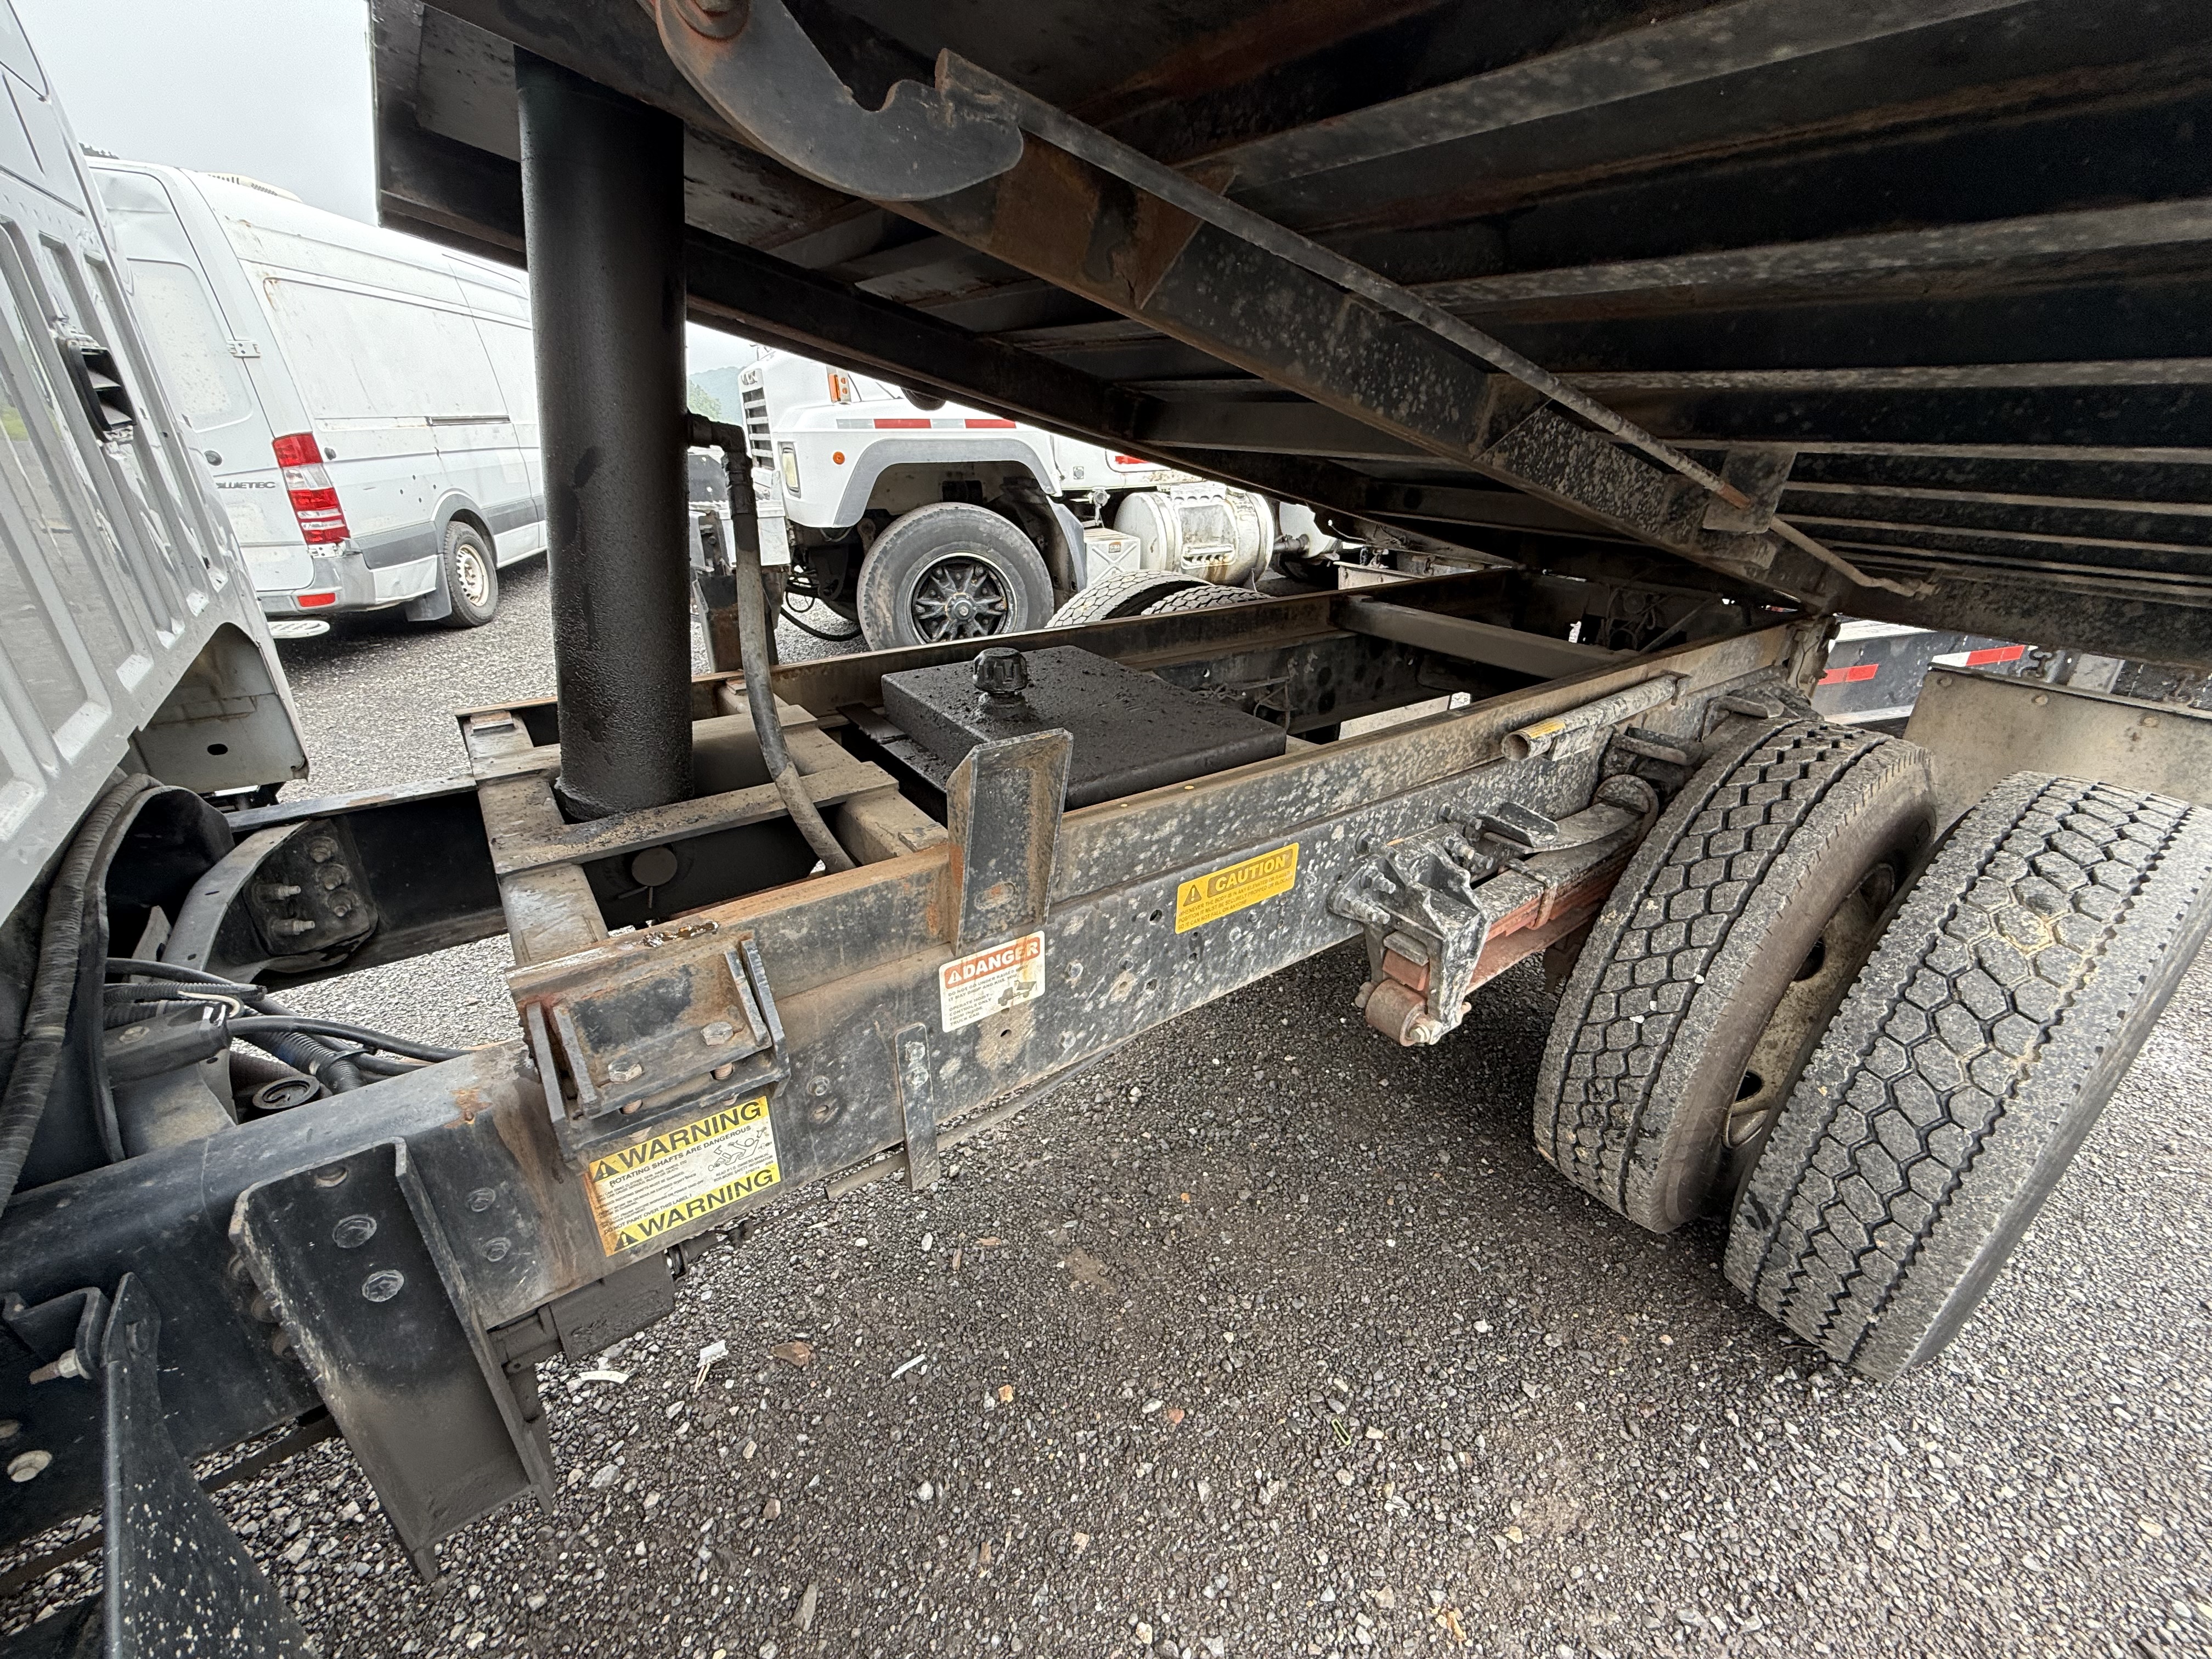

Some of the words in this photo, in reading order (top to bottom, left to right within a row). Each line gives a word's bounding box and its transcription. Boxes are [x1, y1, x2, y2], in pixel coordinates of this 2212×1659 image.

[1215, 854, 1286, 892] CAUTION
[1178, 903, 1204, 917] WHENEVER
[1247, 878, 1268, 890] ELEVATED
[1178, 911, 1199, 924] POSITION
[1205, 904, 1217, 913] MUST
[1225, 893, 1247, 905] SECURELY
[1248, 884, 1267, 896] PROPPED
[1190, 917, 1200, 925] CAN
[1201, 913, 1210, 921] NOT
[1211, 909, 1221, 917] FALL
[1230, 899, 1246, 910] ANYONE
[963, 941, 1039, 979] DANGER
[978, 976, 995, 986] UNDER
[996, 969, 1014, 979] RAISED
[949, 1000, 972, 1012] OPERATE
[974, 993, 989, 1002] HOIST
[949, 1003, 977, 1017] CONTROLS
[978, 997, 991, 1005] ONLY
[967, 986, 981, 995] DROP
[950, 1013, 964, 1021] FROM
[966, 1006, 982, 1015] INSIDE
[950, 1017, 967, 1026] TRUCK
[617, 1101, 761, 1169] WARNING
[609, 1165, 650, 1186] ROTATING
[651, 1152, 684, 1169] SHAFTS
[685, 1144, 702, 1156] ARE
[703, 1125, 751, 1148] DANGEROUS
[613, 1221, 625, 1229] NOT
[626, 1214, 642, 1224] PAINT
[644, 1207, 659, 1217] OVER
[659, 1201, 672, 1210] THIS
[673, 1194, 689, 1205] LABEL
[637, 1169, 773, 1238] WARNING
